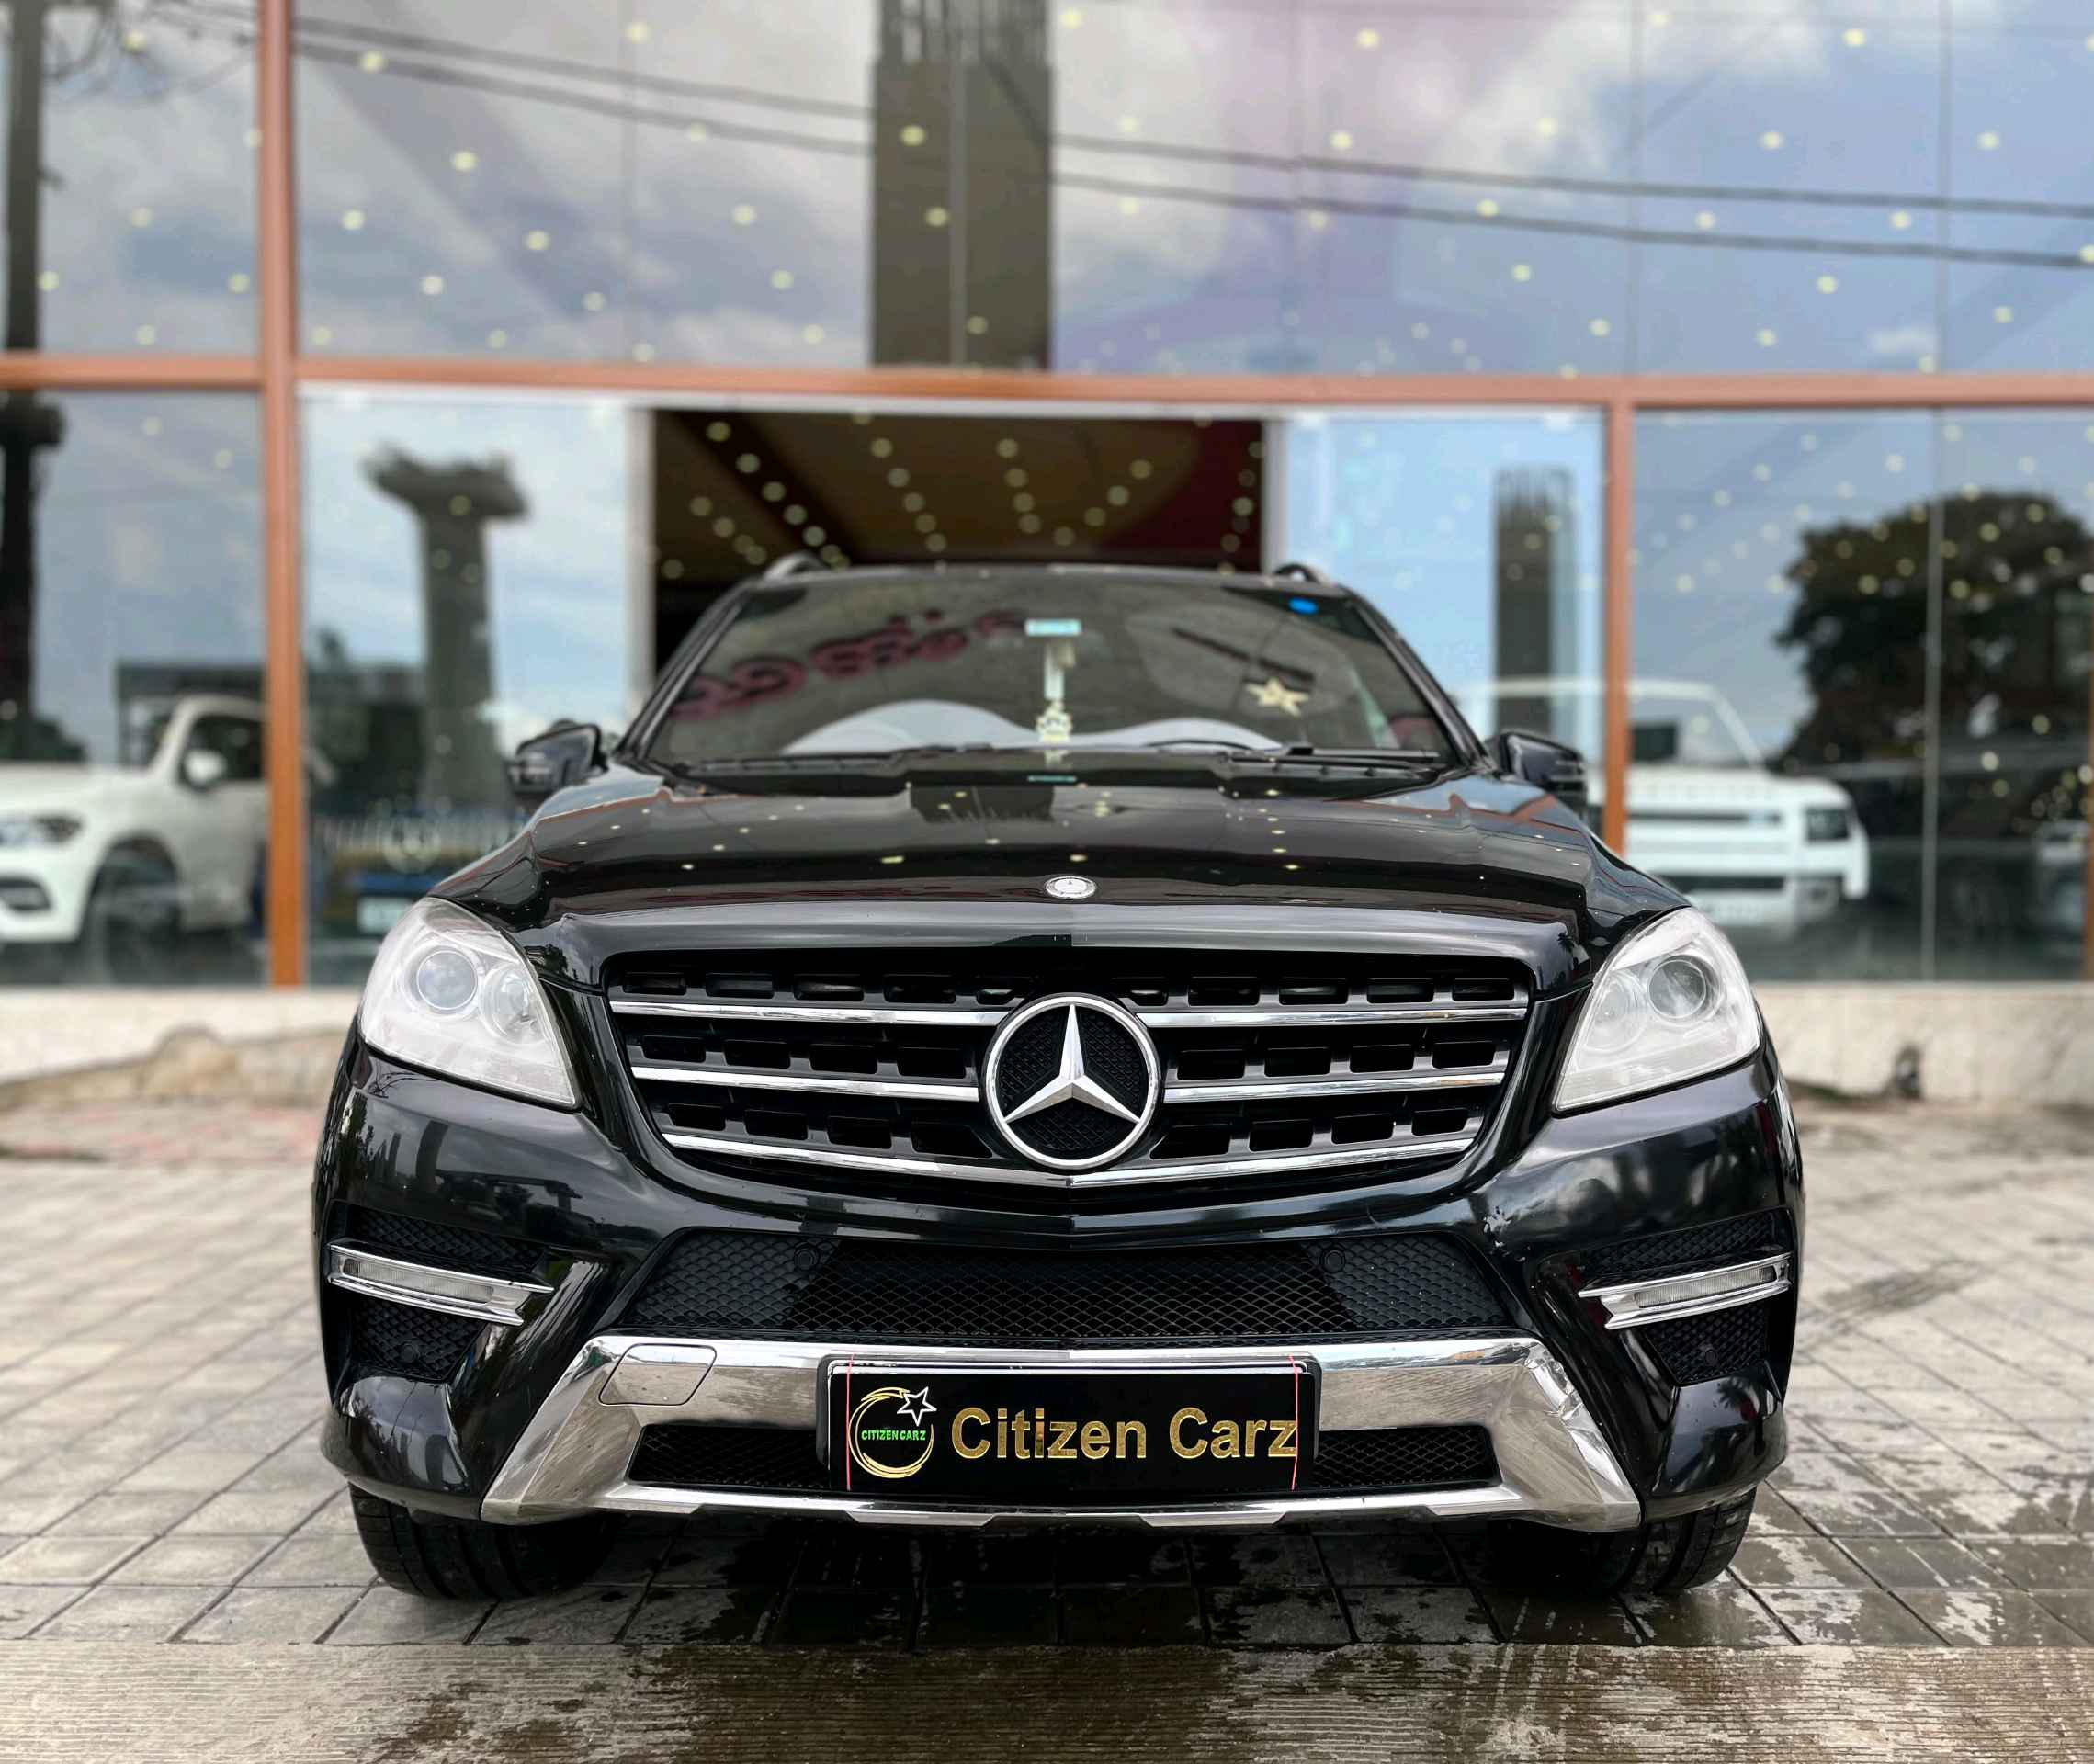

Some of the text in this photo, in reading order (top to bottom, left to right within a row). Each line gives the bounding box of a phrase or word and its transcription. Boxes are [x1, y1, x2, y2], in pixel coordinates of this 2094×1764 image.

[861, 1430, 926, 1441] CITIZEN CARZ
[952, 1407, 1297, 1459] Citizen Carz
